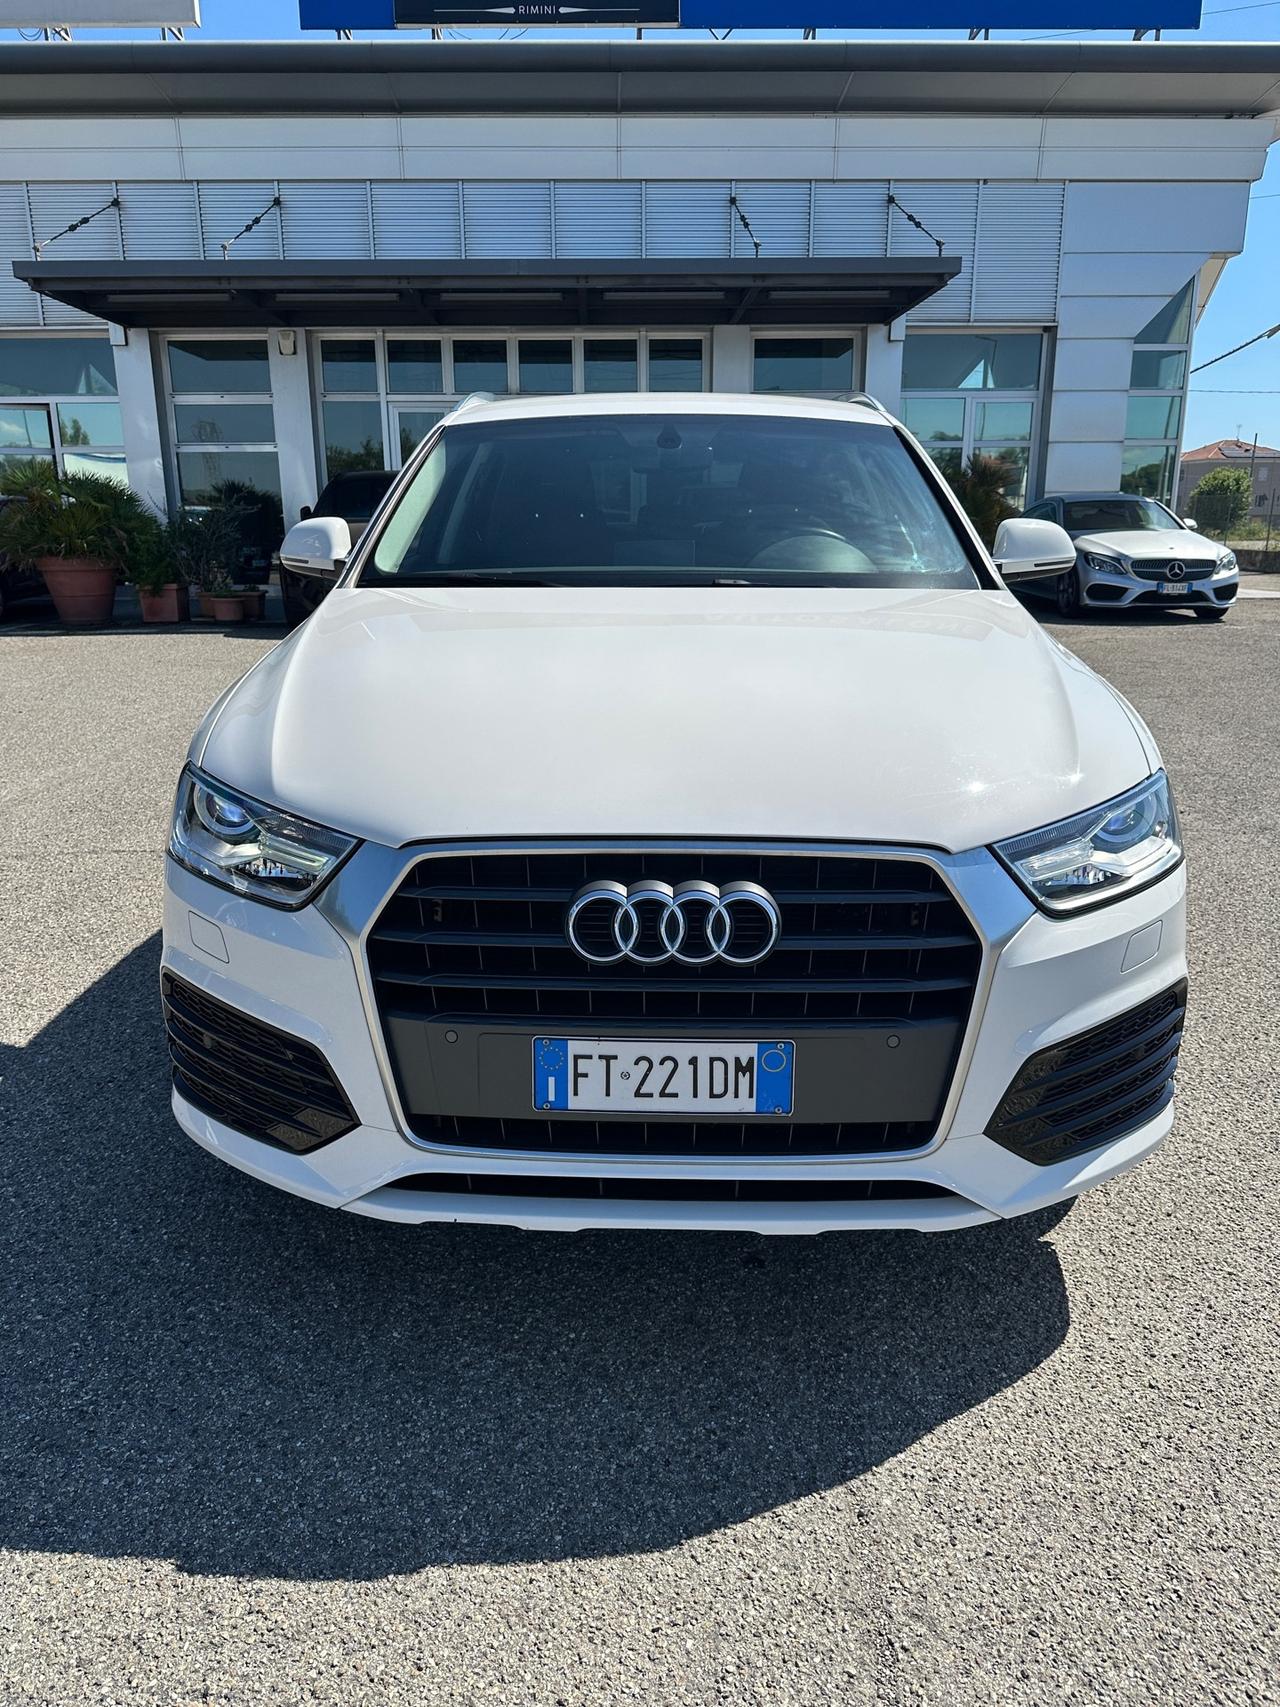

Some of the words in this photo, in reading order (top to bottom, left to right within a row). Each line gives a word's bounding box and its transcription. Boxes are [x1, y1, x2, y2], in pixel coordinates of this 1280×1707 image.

[518, 5, 556, 15] RIMINI
[548, 1076, 556, 1102] I
[572, 1054, 619, 1097] FT
[633, 1055, 755, 1099] 221DM
